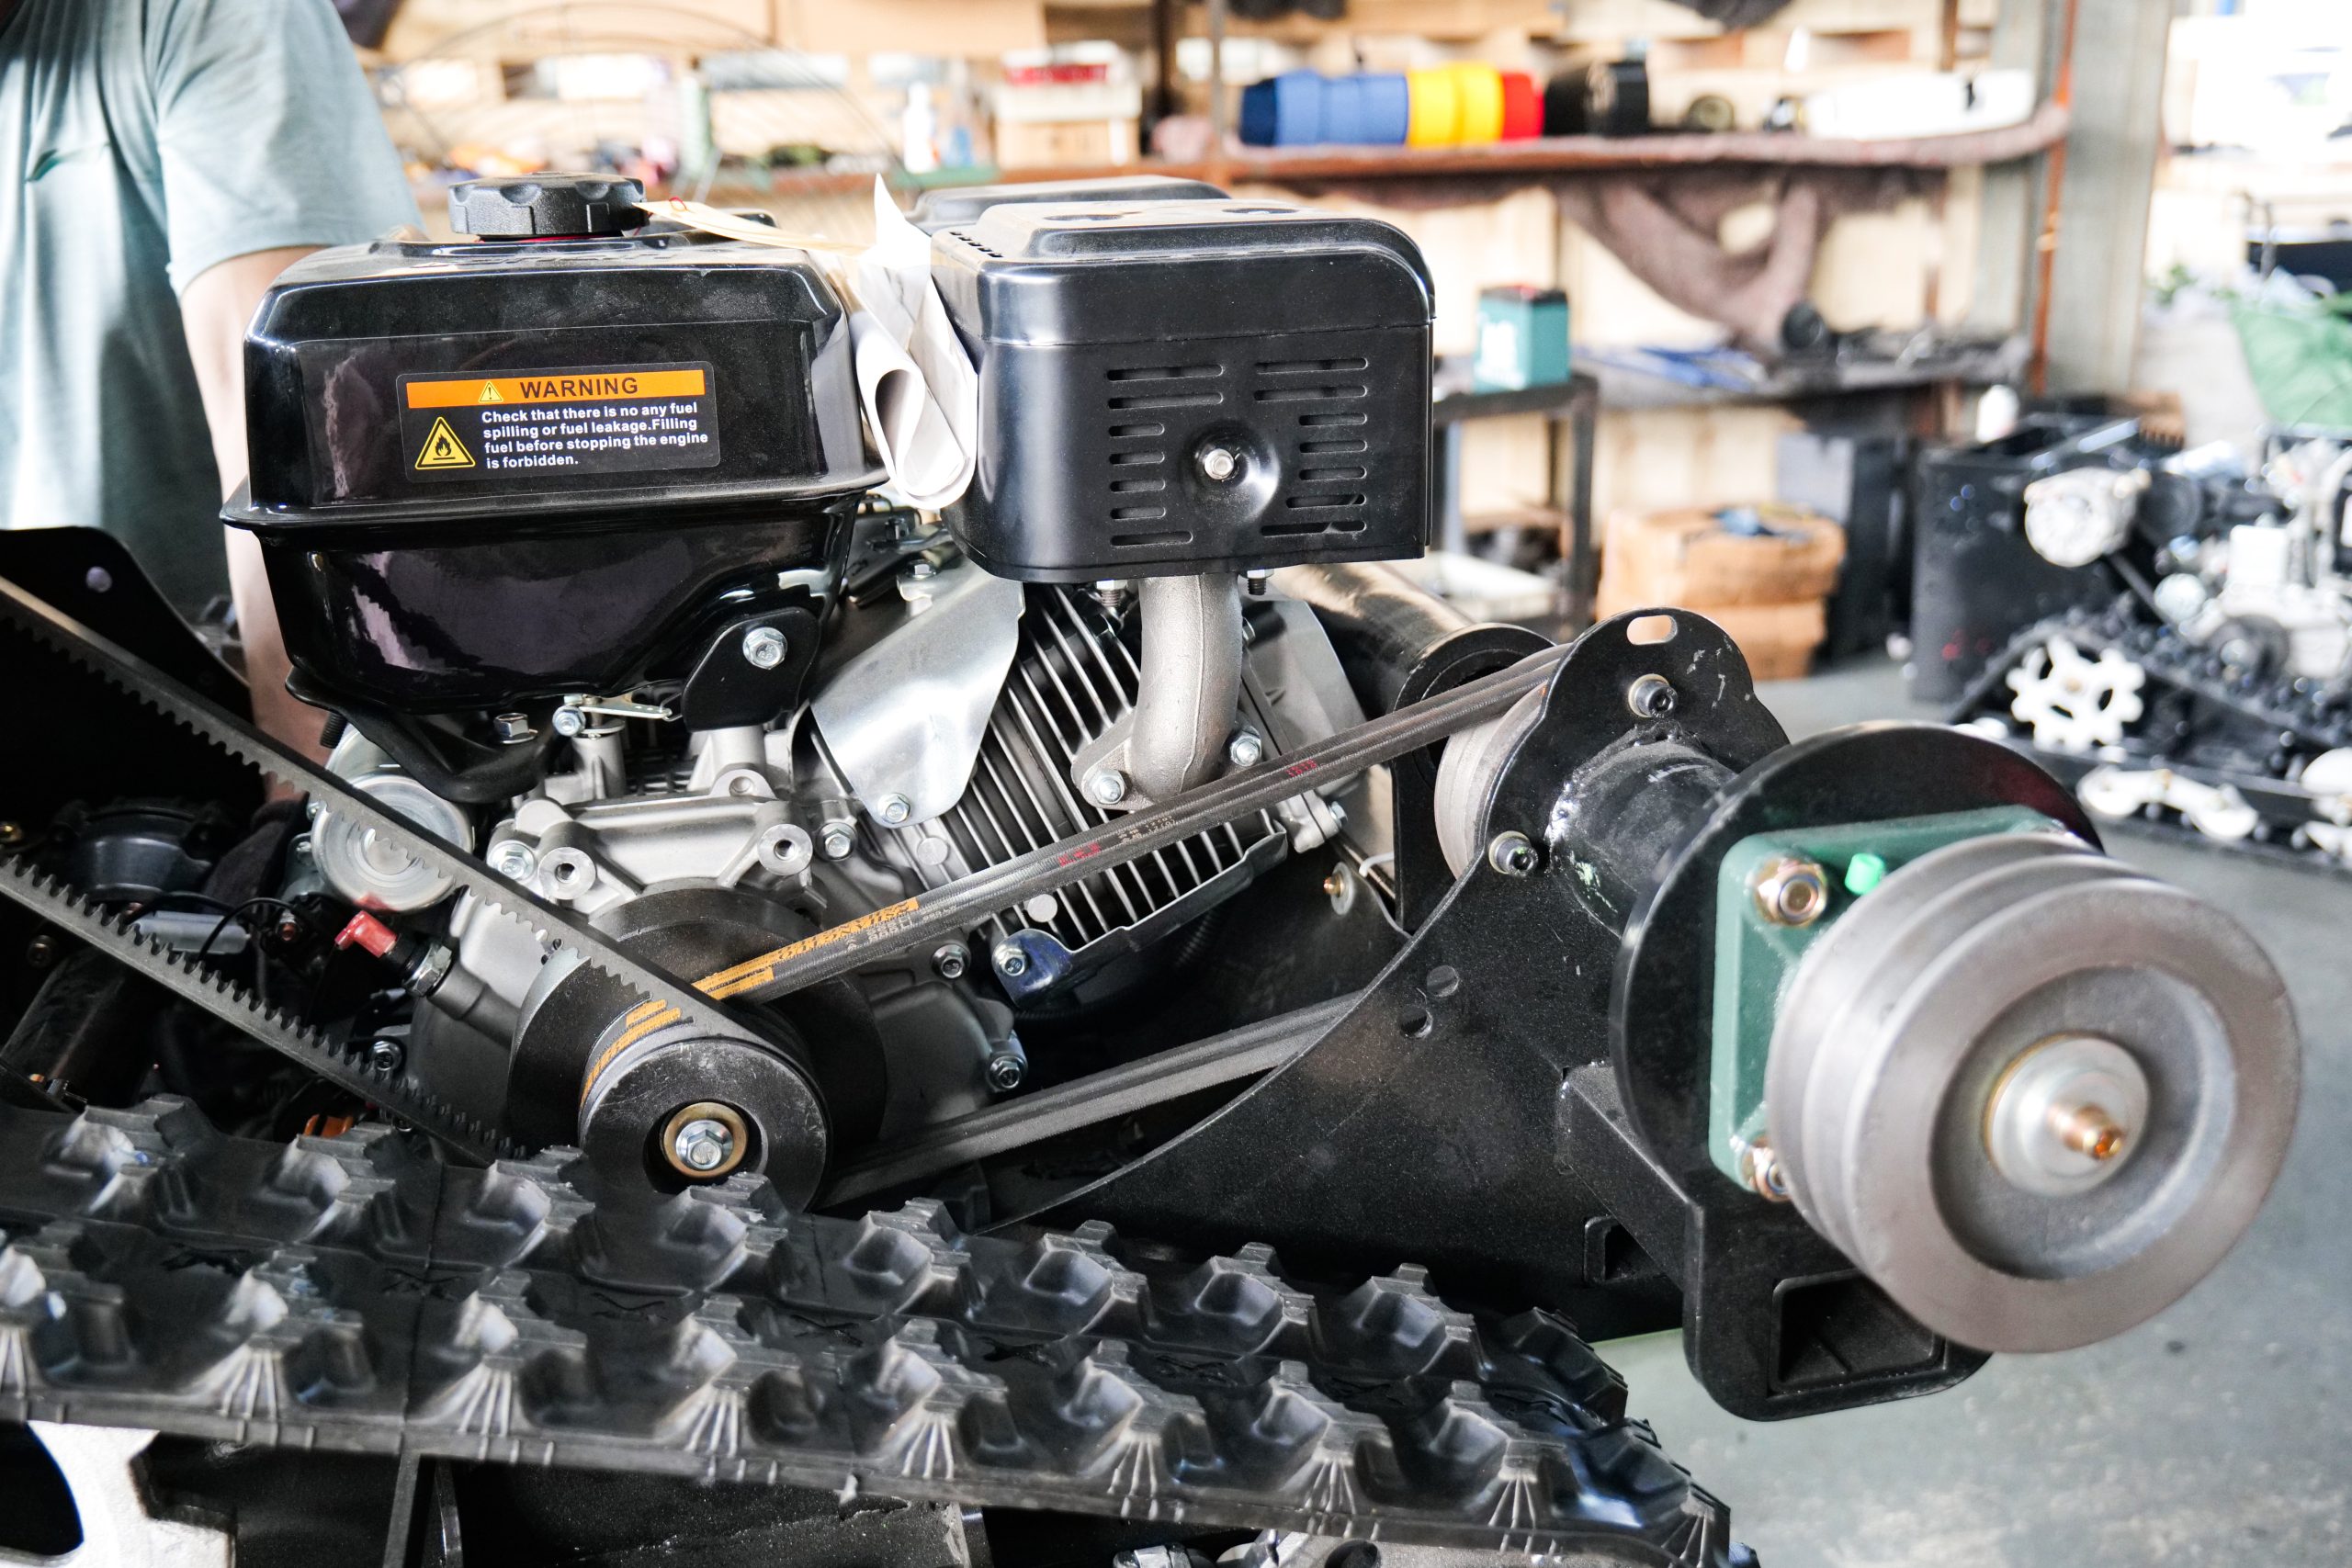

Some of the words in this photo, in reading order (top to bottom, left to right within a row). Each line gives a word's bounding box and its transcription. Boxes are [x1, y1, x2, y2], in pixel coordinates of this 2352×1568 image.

[520, 377, 639, 400] WARNING
[482, 410, 528, 423] Check
[531, 409, 560, 421] that
[562, 408, 601, 419] there
[604, 406, 616, 417] is
[620, 407, 639, 416] no
[641, 406, 667, 419] any
[670, 401, 697, 414] fuel
[483, 425, 538, 440] spilling
[542, 426, 558, 436] or
[560, 423, 588, 434] fuel
[485, 441, 513, 453] fuel
[516, 437, 563, 452] before
[567, 436, 631, 451] stopping
[634, 434, 657, 446] the
[660, 433, 708, 446] engine
[487, 457, 499, 468] is
[503, 455, 578, 468] forbidden.
